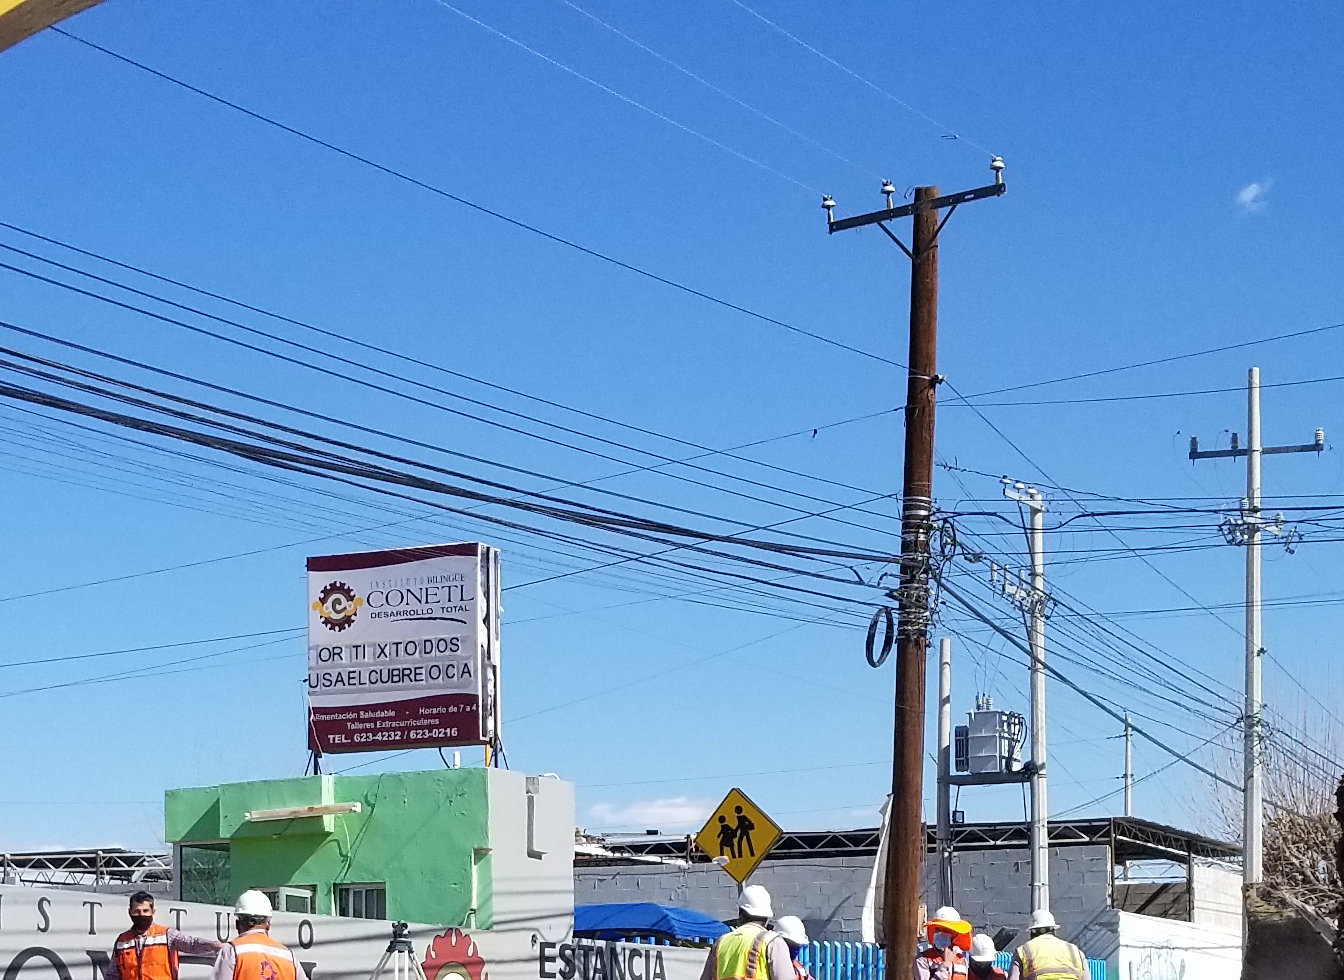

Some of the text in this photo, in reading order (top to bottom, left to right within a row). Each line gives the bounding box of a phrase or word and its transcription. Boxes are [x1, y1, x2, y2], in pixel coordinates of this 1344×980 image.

[366, 585, 475, 609] CONETL
[370, 605, 470, 619] DESARROLLO TOTAL
[318, 647, 343, 663] OR
[360, 709, 396, 719] Saludable
[419, 705, 446, 715] Horario
[449, 704, 458, 713] de
[459, 704, 464, 712] 7
[472, 703, 477, 711] 4
[346, 718, 440, 731] Talleres Extracurriculares
[328, 734, 352, 744] TEL.
[353, 731, 402, 741] 623-4232
[409, 728, 458, 739] 623-0216
